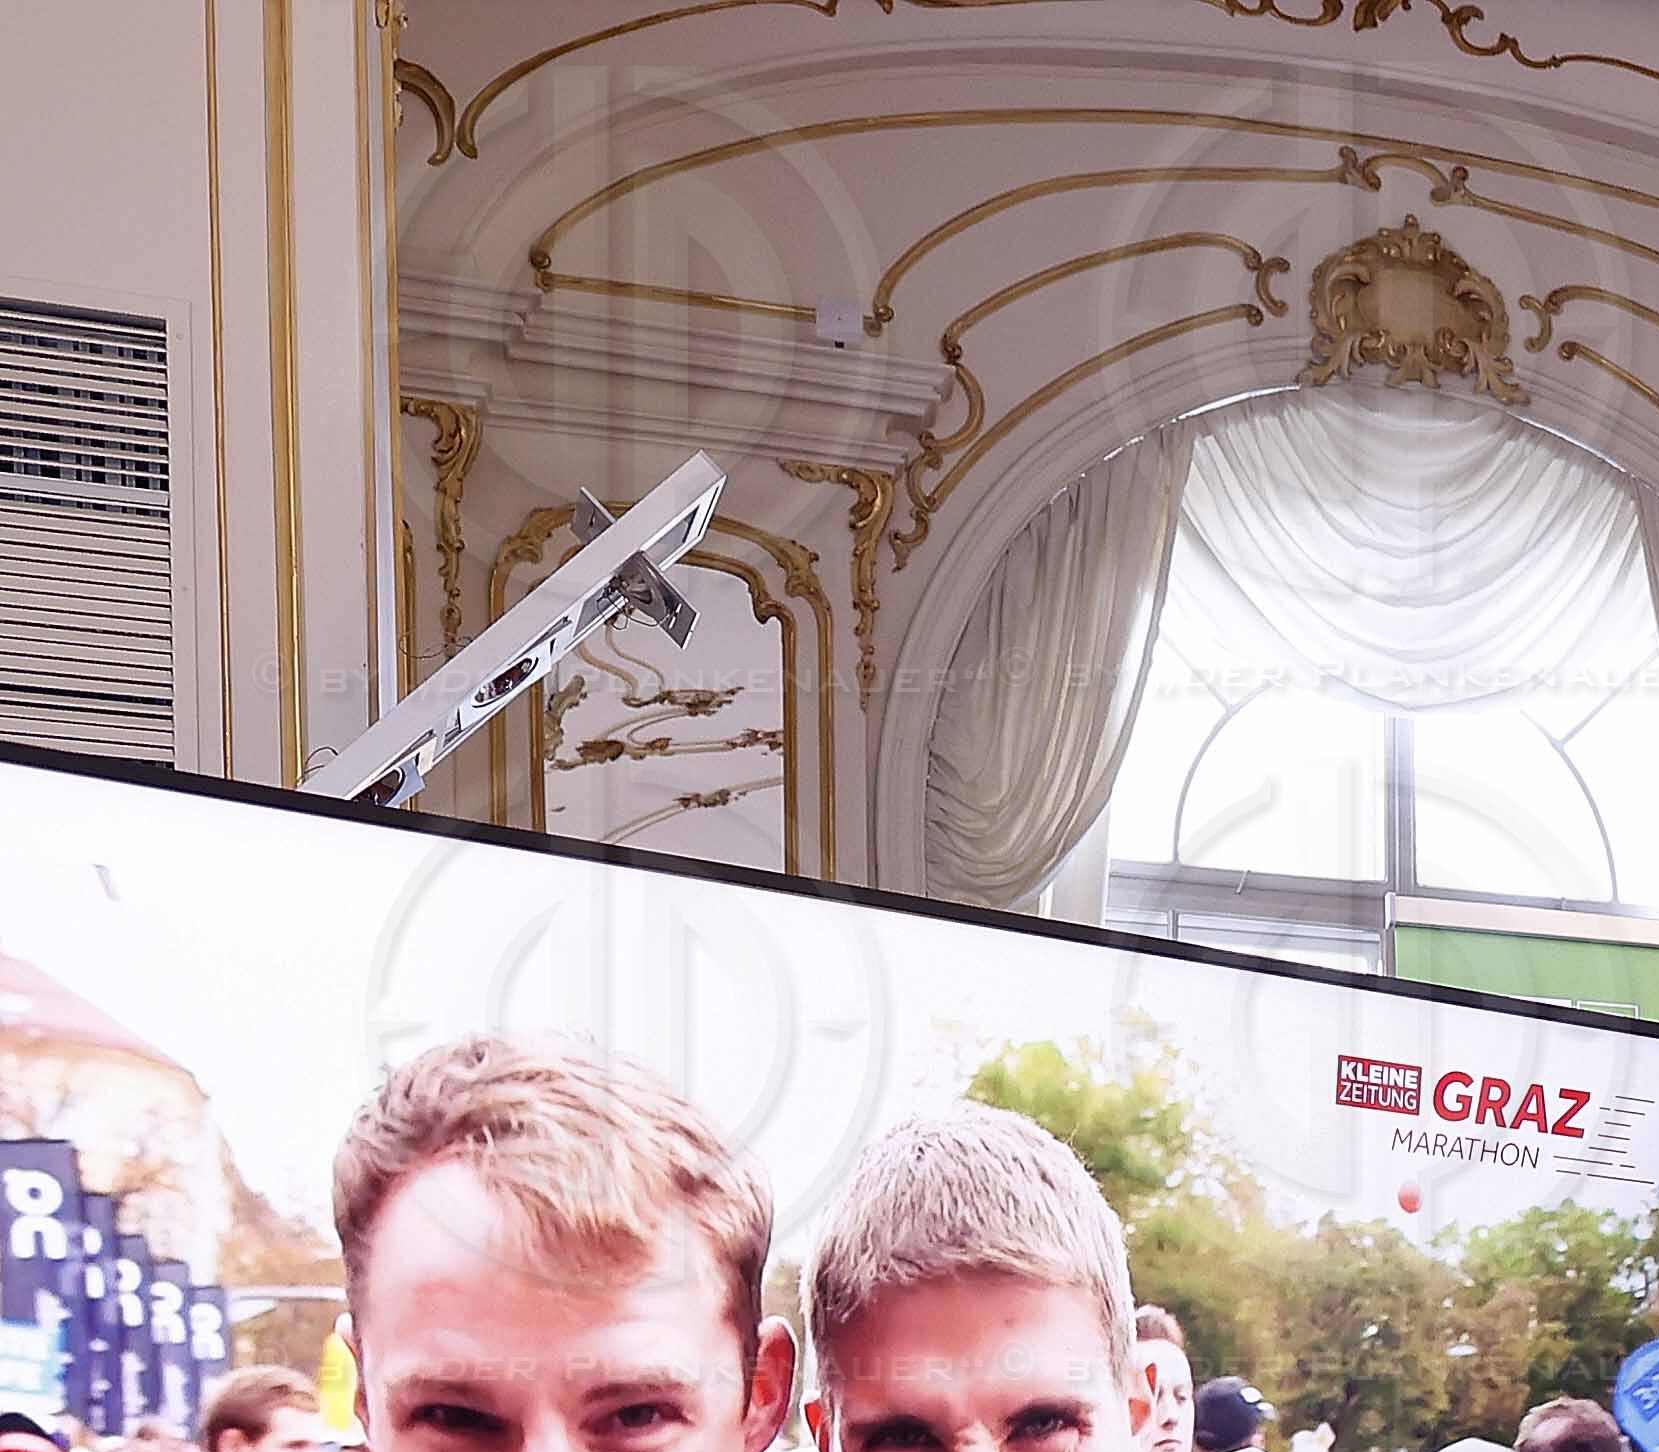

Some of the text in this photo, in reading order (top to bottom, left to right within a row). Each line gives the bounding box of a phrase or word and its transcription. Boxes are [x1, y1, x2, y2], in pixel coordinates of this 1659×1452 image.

[1339, 1082, 1418, 1111] ZEITUNG
[1340, 1061, 1591, 1138] KLEINE GRAZ
[1391, 1128, 1539, 1168] MARATHON
